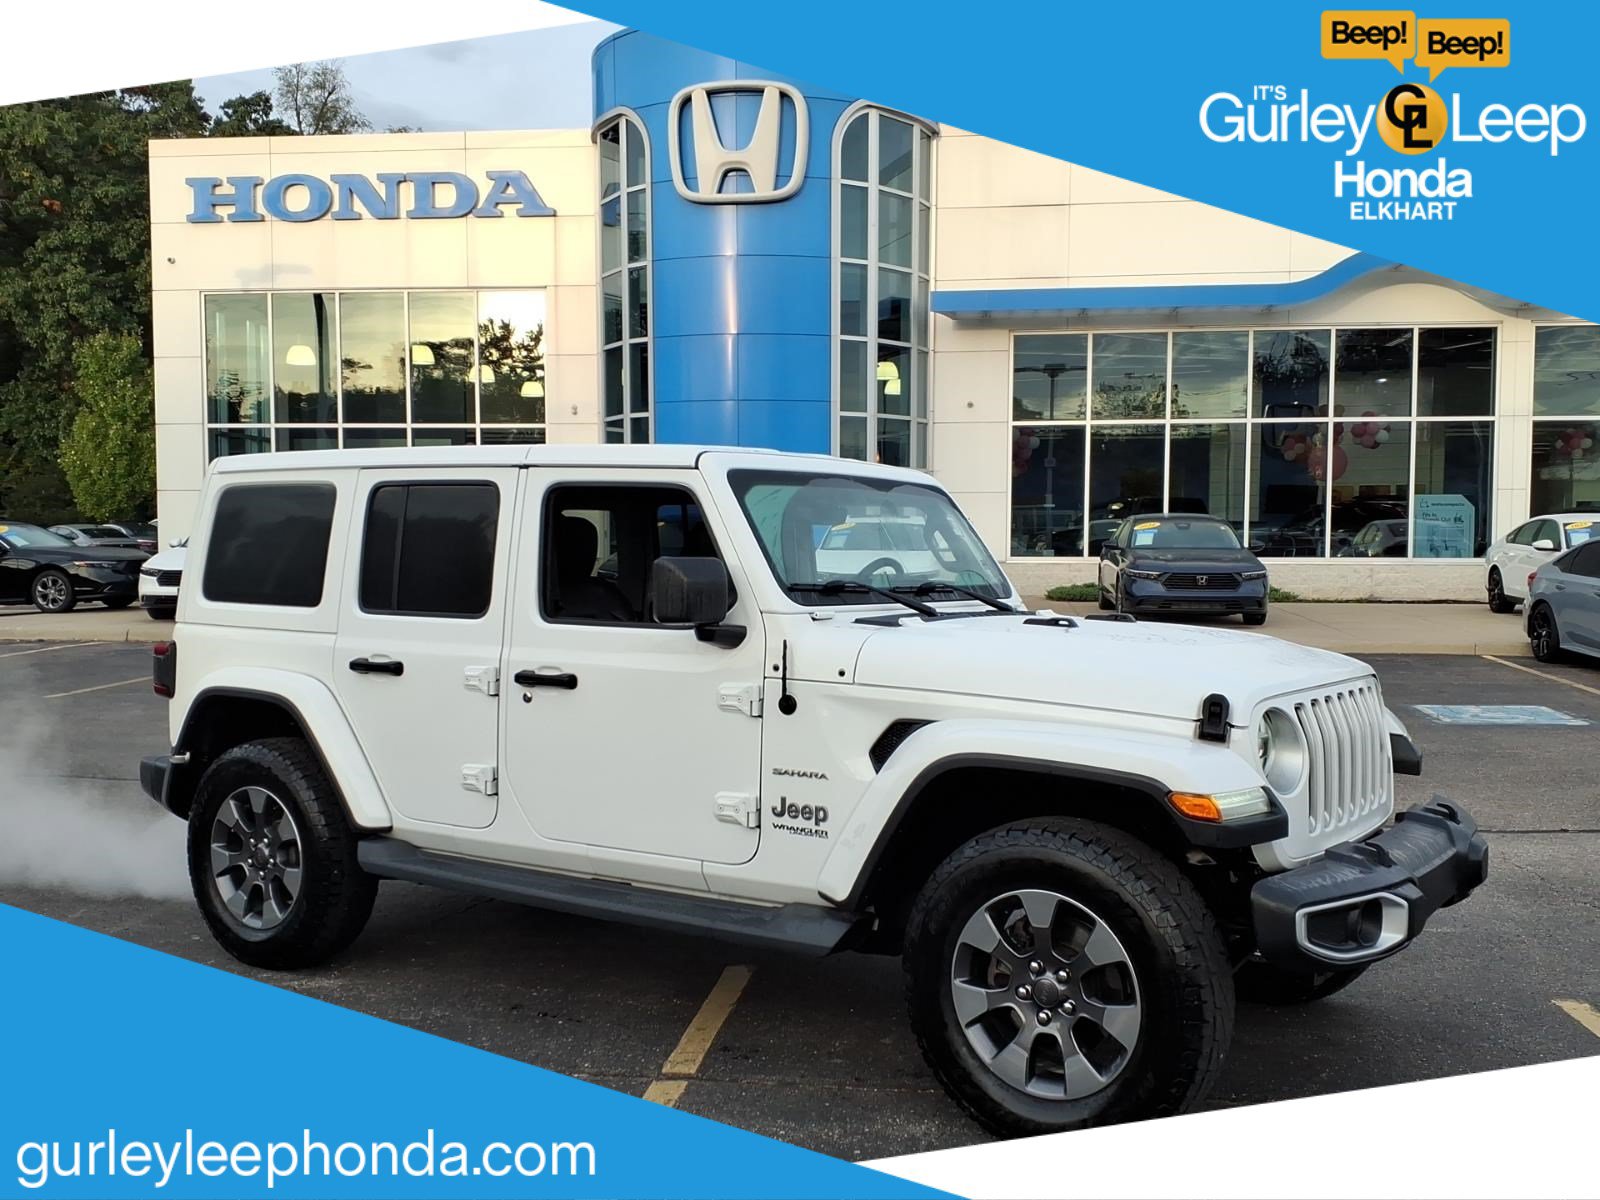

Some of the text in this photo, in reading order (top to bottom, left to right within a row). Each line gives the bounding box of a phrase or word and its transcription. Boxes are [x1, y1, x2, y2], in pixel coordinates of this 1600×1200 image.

[185, 170, 557, 223] HONDA
[772, 767, 829, 781] SAHARA
[771, 796, 829, 827] Jeep
[772, 822, 828, 837] WRANGLER
